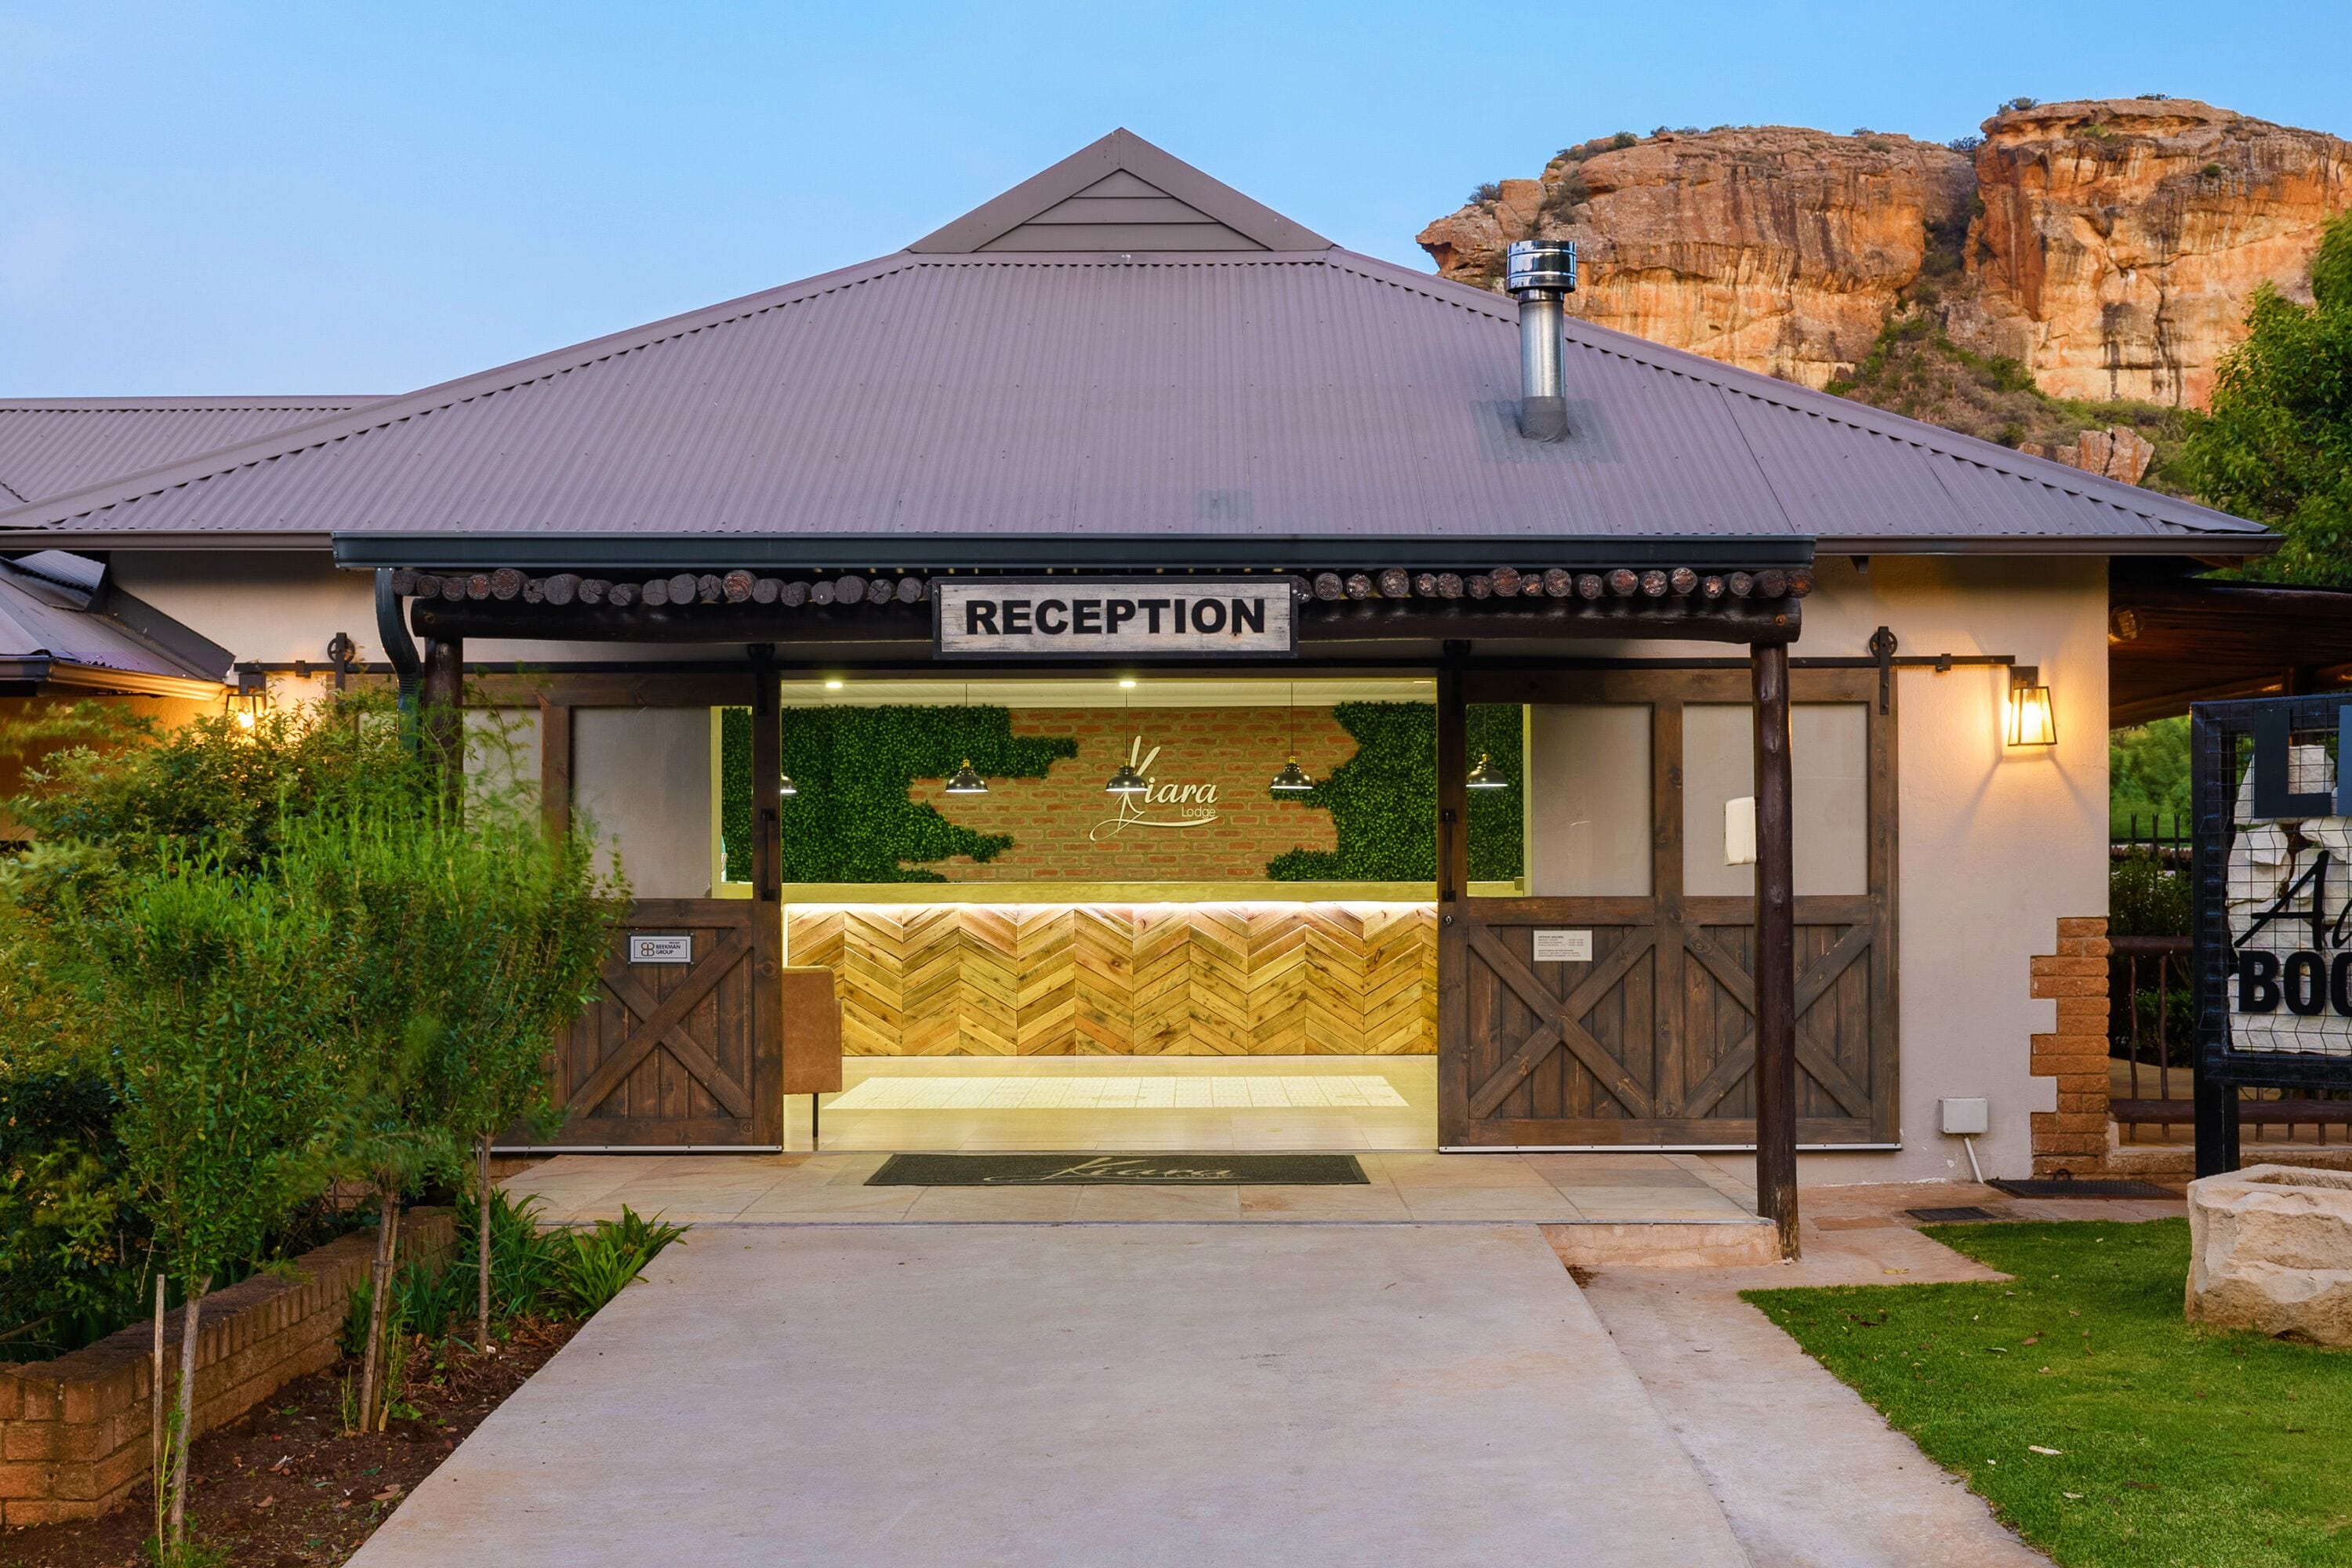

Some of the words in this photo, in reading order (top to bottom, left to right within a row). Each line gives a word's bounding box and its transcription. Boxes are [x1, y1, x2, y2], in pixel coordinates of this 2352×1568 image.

[965, 598, 1265, 635] RECEPTION
[1089, 735, 1218, 841] Kiara
[1181, 806, 1216, 819] Lodge
